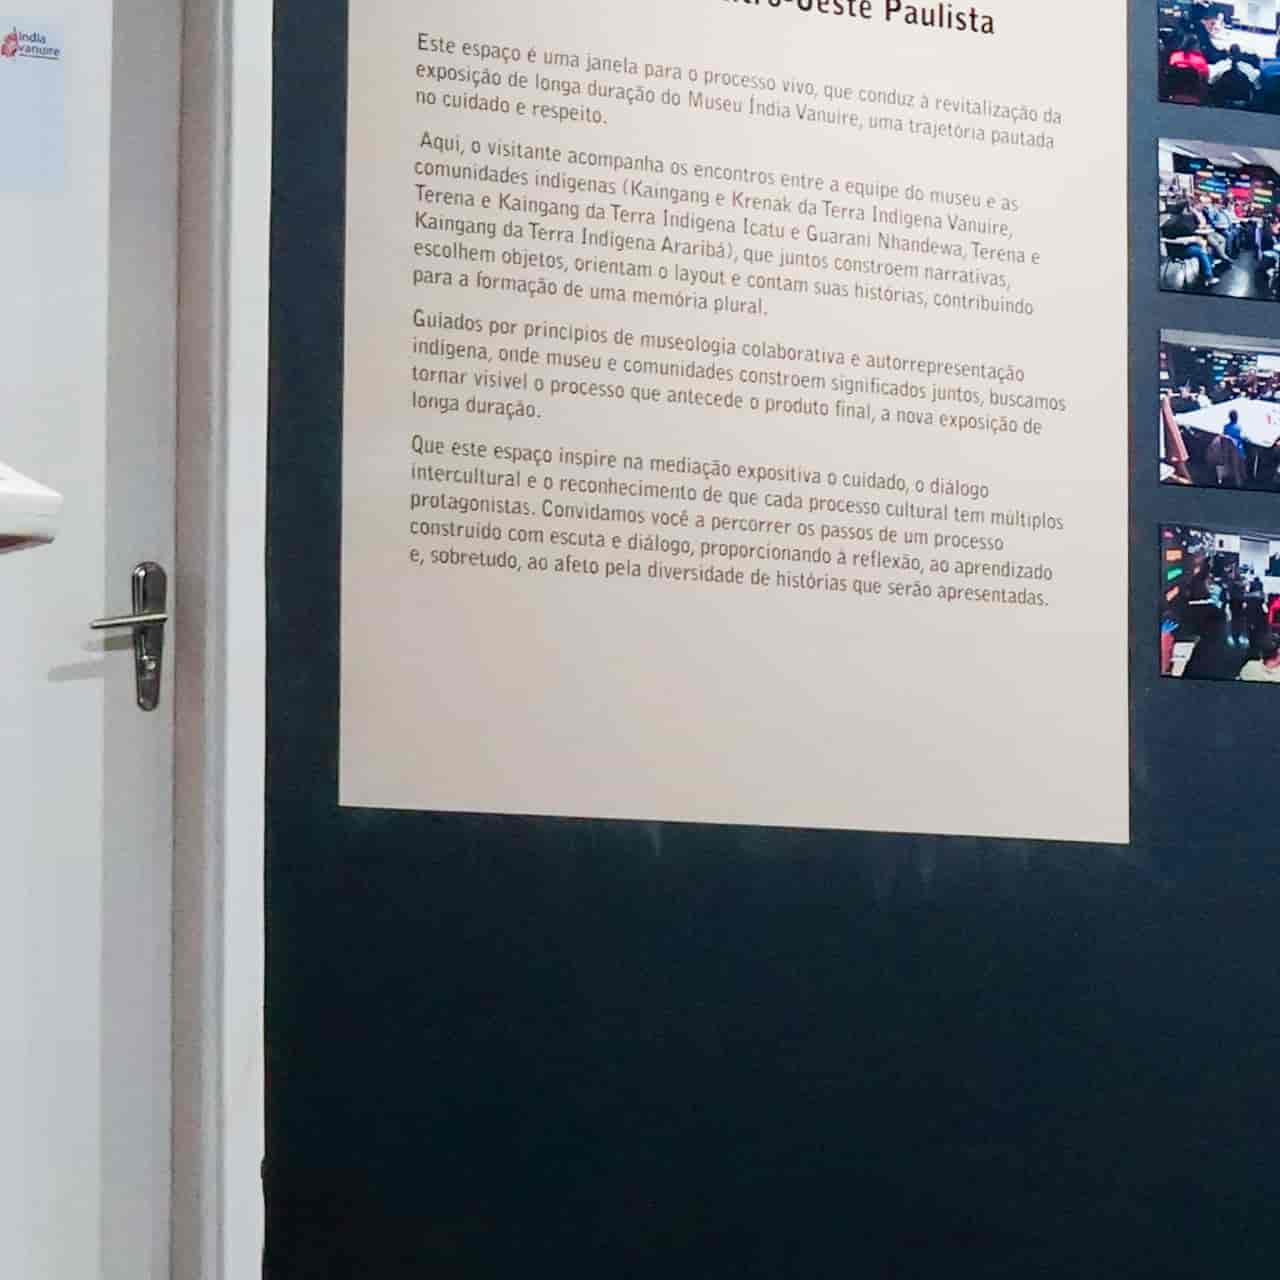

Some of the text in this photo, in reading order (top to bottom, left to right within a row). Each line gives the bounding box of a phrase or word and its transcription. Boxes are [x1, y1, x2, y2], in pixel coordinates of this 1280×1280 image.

[414, 62, 1054, 150] exposição longa duração Museu Índia Vanuire, uma pautada
[416, 30, 1038, 125] Este espaço uma janela para processo vivo, que conduz revitalização
[441, 91, 608, 125] cuidado respeito.
[412, 160, 529, 186] comunidades
[731, 190, 792, 213] Krenak
[820, 198, 865, 222] Terra
[946, 212, 1013, 241] Vanuire,
[418, 129, 981, 208] Aqui, visitante acompanha encontros entre equipe museu
[412, 182, 475, 207] Terena
[497, 190, 580, 221] Kaingang
[608, 202, 656, 225] Terra
[742, 215, 785, 239] Icatu
[805, 222, 871, 248] Guarani
[969, 239, 1025, 264] Terena
[414, 209, 497, 240] Kaingang
[526, 220, 574, 244] Terra
[742, 246, 774, 265] que
[777, 251, 829, 270] juntos
[833, 255, 919, 278] constroem
[923, 266, 1011, 292] narrativas,
[411, 267, 768, 317] para formação uma memória plural.
[412, 240, 1034, 316] escolhem objetos, orientam layout contam suas contribuindo
[411, 307, 1025, 385] Guiados por museologia colaborativa autorrepresentação
[496, 345, 540, 366] onde
[545, 351, 601, 370] museu
[622, 358, 734, 382] comunidades
[737, 367, 826, 389] constroem
[830, 375, 926, 400] significados
[929, 382, 985, 408] juntos,
[988, 386, 1067, 412] buscamos
[411, 364, 1019, 436] tornar processo que antecede produto final, nova exposição
[411, 390, 542, 421] longa duração.
[410, 432, 989, 501] Que este espaço inspire mediação expositiva cuidado, diálogo
[410, 461, 985, 523] intercultural reconhecimento que cada processo cultural tem
[409, 491, 1004, 552] protagonistas. Convidamos você percorrer passos processo
[507, 526, 544, 544] com
[548, 529, 606, 548] escuta
[626, 531, 695, 557] diálogo,
[699, 540, 832, 565] proporcionando
[953, 559, 1053, 582] aprendizado
[429, 546, 1049, 607] sobretudo, afeto pela diversidade histórias que serão apresentadas.
